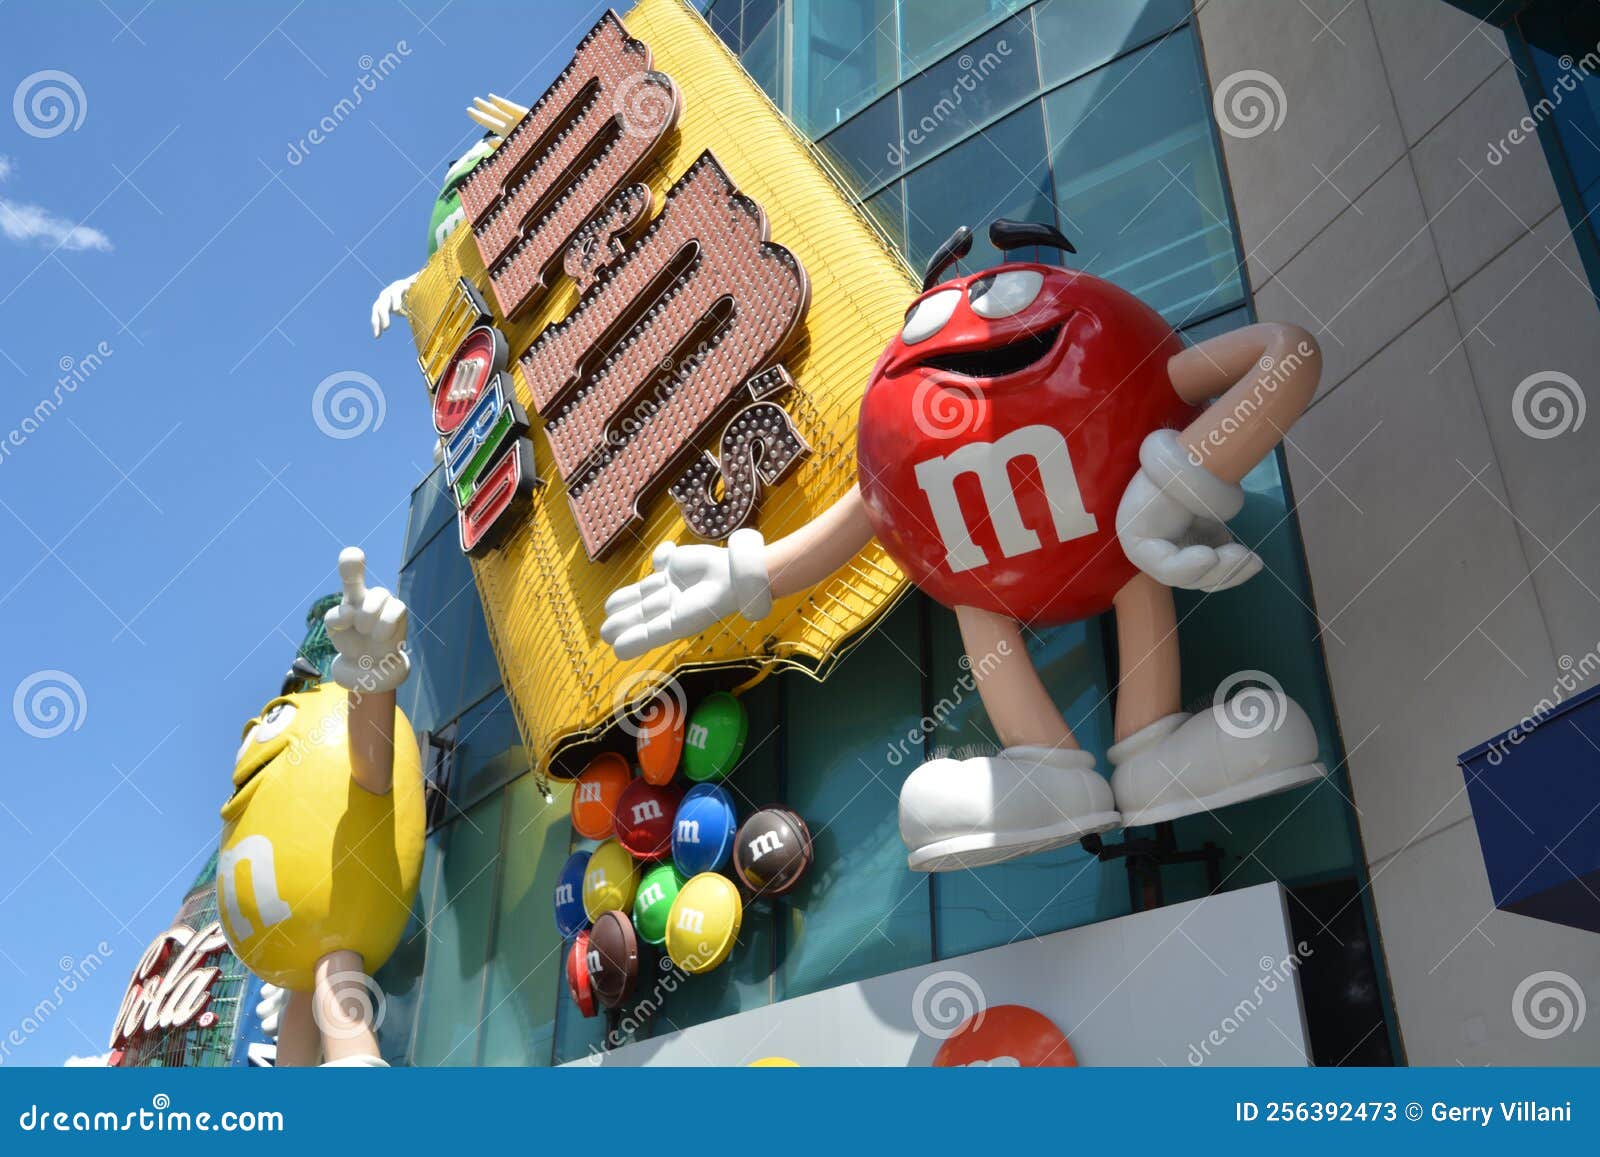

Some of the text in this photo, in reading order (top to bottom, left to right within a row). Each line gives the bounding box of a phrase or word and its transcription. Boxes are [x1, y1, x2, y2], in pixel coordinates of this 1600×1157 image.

[913, 424, 1098, 574] m
[686, 723, 709, 750] m
[579, 781, 602, 803] m
[631, 799, 663, 825] m
[677, 819, 700, 843] m
[748, 830, 784, 861] m
[555, 883, 574, 907] m
[638, 882, 665, 913] m
[677, 907, 704, 934] m
